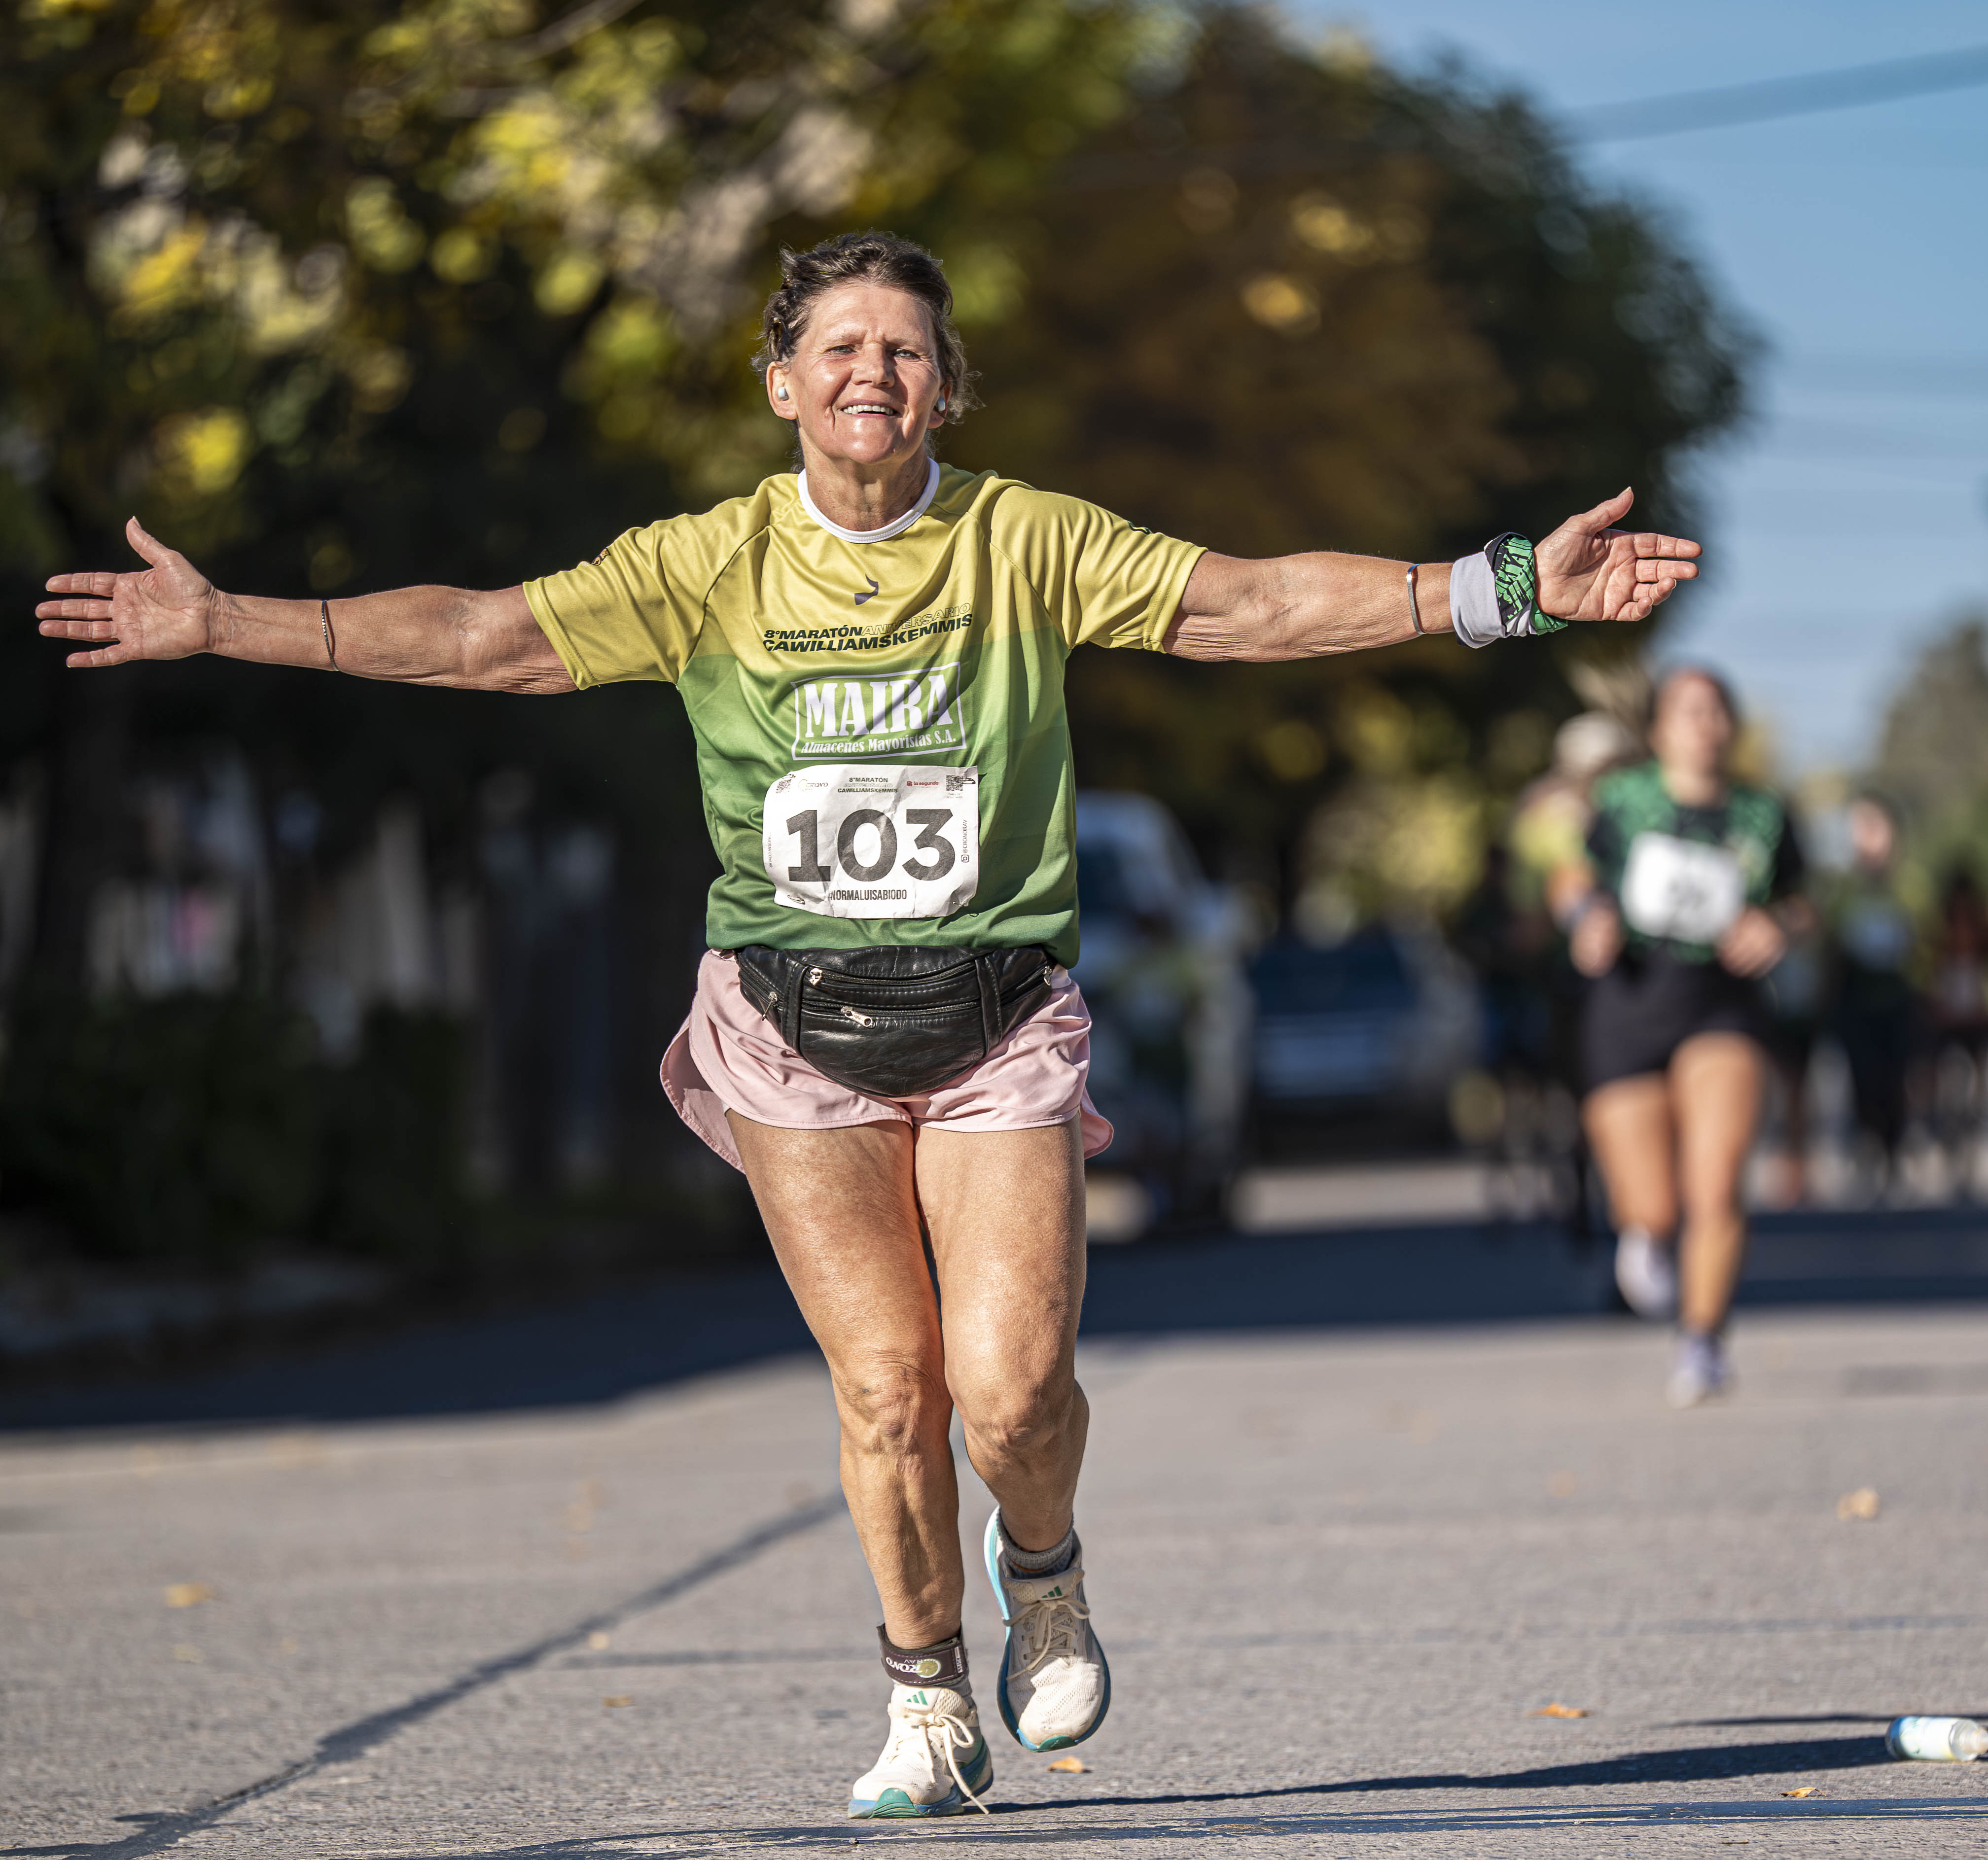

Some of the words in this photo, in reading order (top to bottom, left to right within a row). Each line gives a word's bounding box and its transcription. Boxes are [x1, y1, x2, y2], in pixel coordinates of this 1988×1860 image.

[763, 614, 973, 652] CAWILLIAMSKEMMIS
[861, 603, 971, 635] ANIVERSARIO
[804, 674, 953, 738] MAIRA
[801, 741, 864, 753] Almacenes
[868, 734, 932, 752] Mayoristas
[934, 729, 956, 744] S.A.
[786, 808, 956, 882] 103
